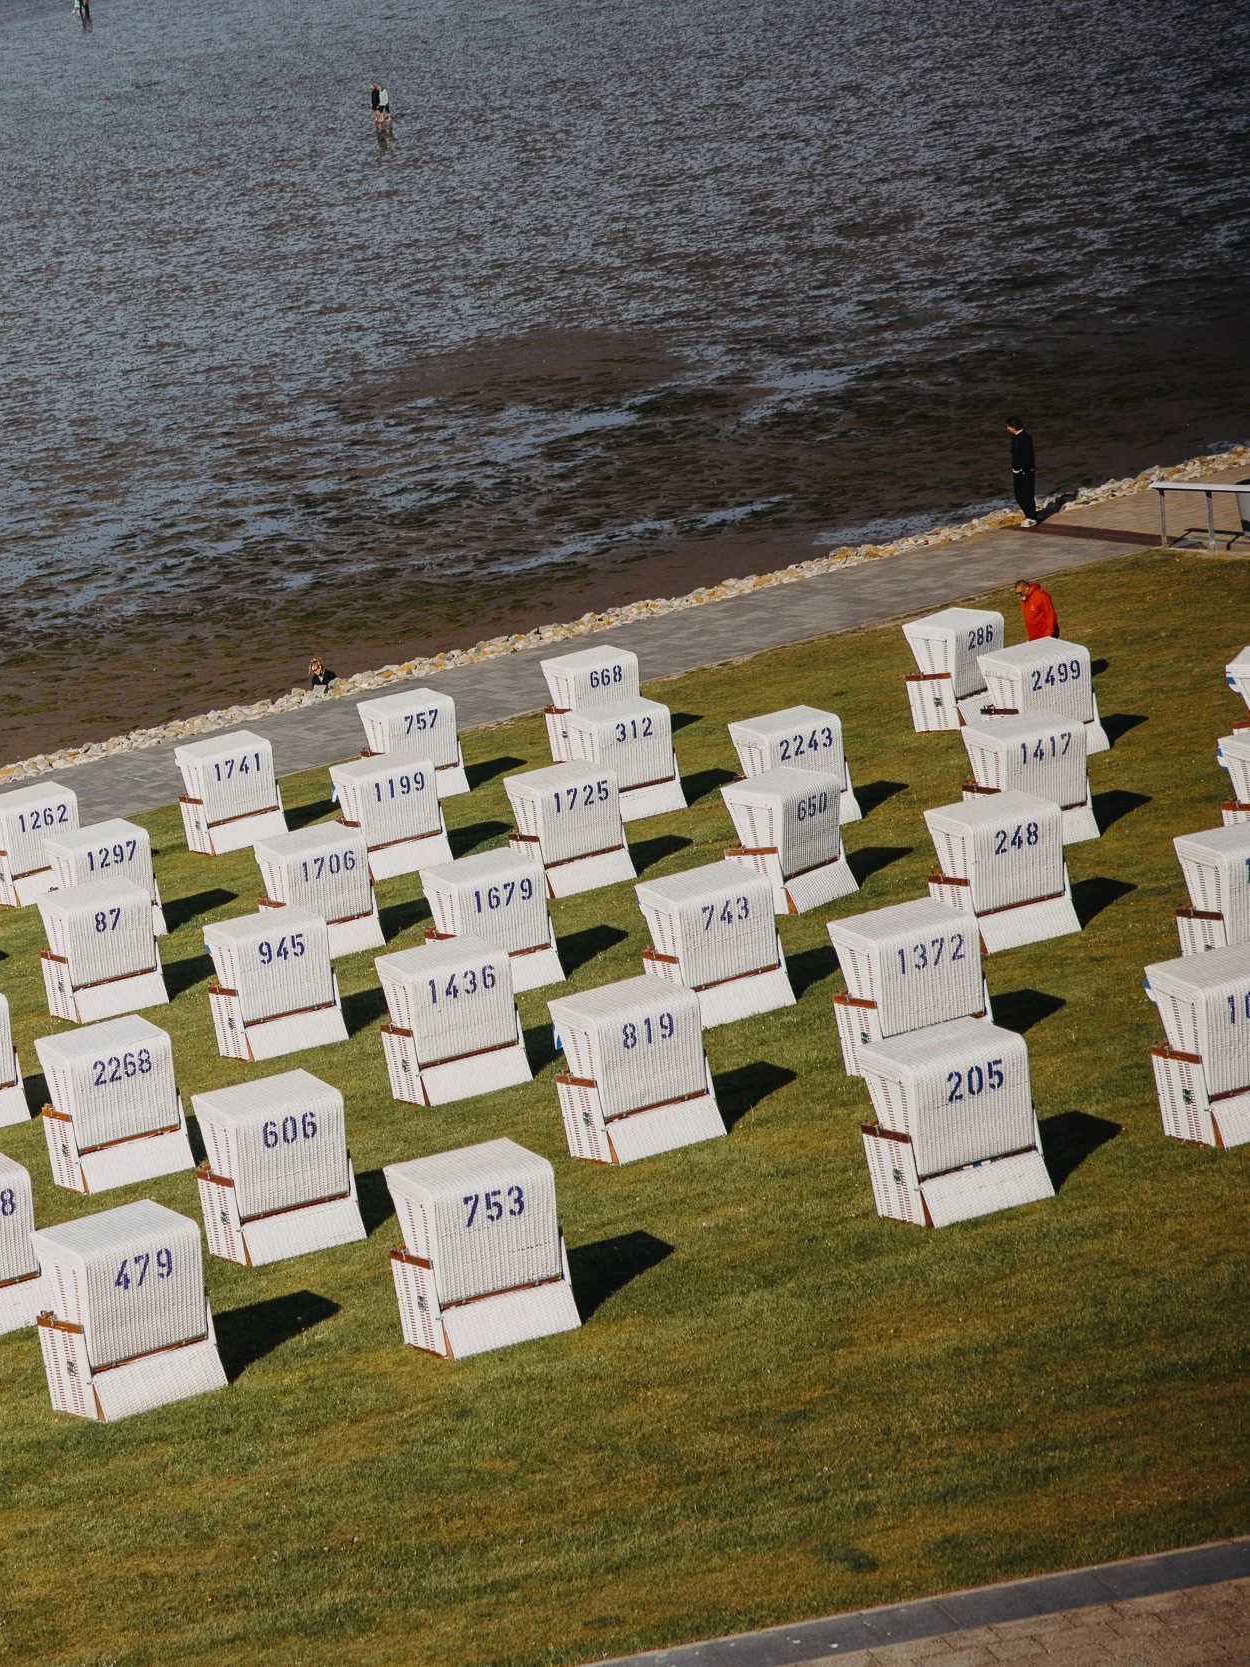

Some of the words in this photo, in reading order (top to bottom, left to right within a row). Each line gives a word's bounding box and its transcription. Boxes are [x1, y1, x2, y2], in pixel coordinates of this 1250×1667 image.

[968, 624, 993, 650] 286
[589, 664, 623, 689] 668
[1031, 660, 1081, 692] 2499
[403, 708, 439, 736] 757
[615, 716, 654, 744] 312
[779, 727, 834, 762] 2243
[1020, 732, 1072, 766] 1417
[214, 752, 261, 782] 1741
[374, 771, 426, 803] 1199
[553, 779, 610, 814] 1725
[18, 803, 69, 834] 1262
[798, 791, 827, 821] 650
[87, 839, 137, 872] 1297
[994, 822, 1040, 856] 248
[301, 849, 357, 883] 1706
[474, 877, 534, 914] 1679
[94, 907, 122, 934] 87
[701, 896, 750, 932] 743
[257, 933, 306, 965] 945
[897, 933, 966, 976] 1372
[428, 964, 497, 1005] 1436
[622, 1012, 675, 1050] 819
[92, 1048, 153, 1087] 2268
[946, 1058, 1005, 1104] 205
[262, 1111, 318, 1149] 606
[462, 1185, 525, 1228] 753
[113, 1247, 174, 1291] 479
